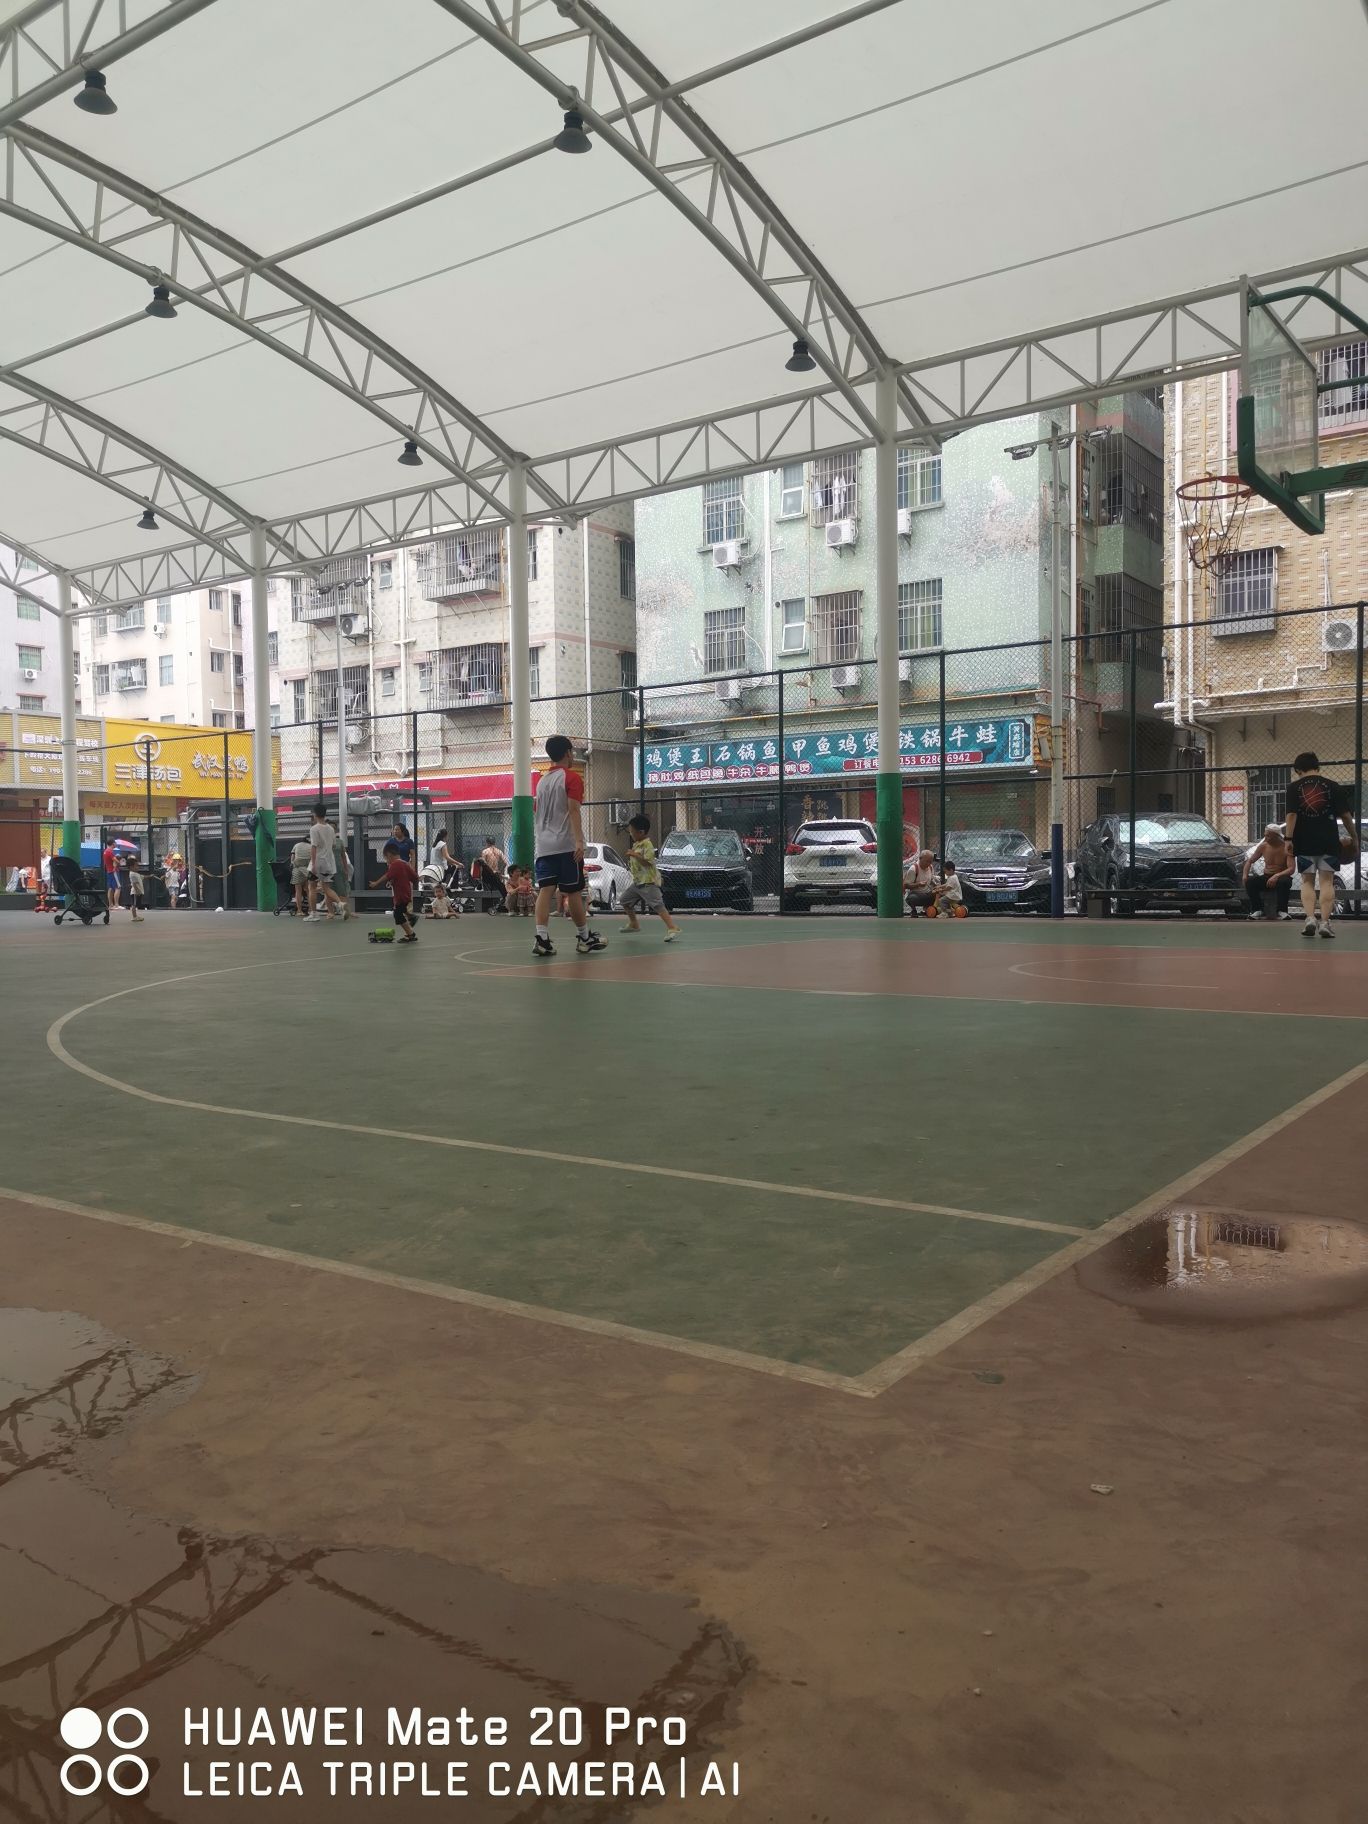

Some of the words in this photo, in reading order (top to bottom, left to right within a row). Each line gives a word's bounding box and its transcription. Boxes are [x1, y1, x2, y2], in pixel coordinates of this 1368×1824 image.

[646, 747, 703, 768] 鸡煲王
[715, 741, 778, 762] 石锅鱼
[900, 756, 916, 766] 153
[946, 753, 971, 763] 6942
[114, 763, 182, 782] 三津汤包
